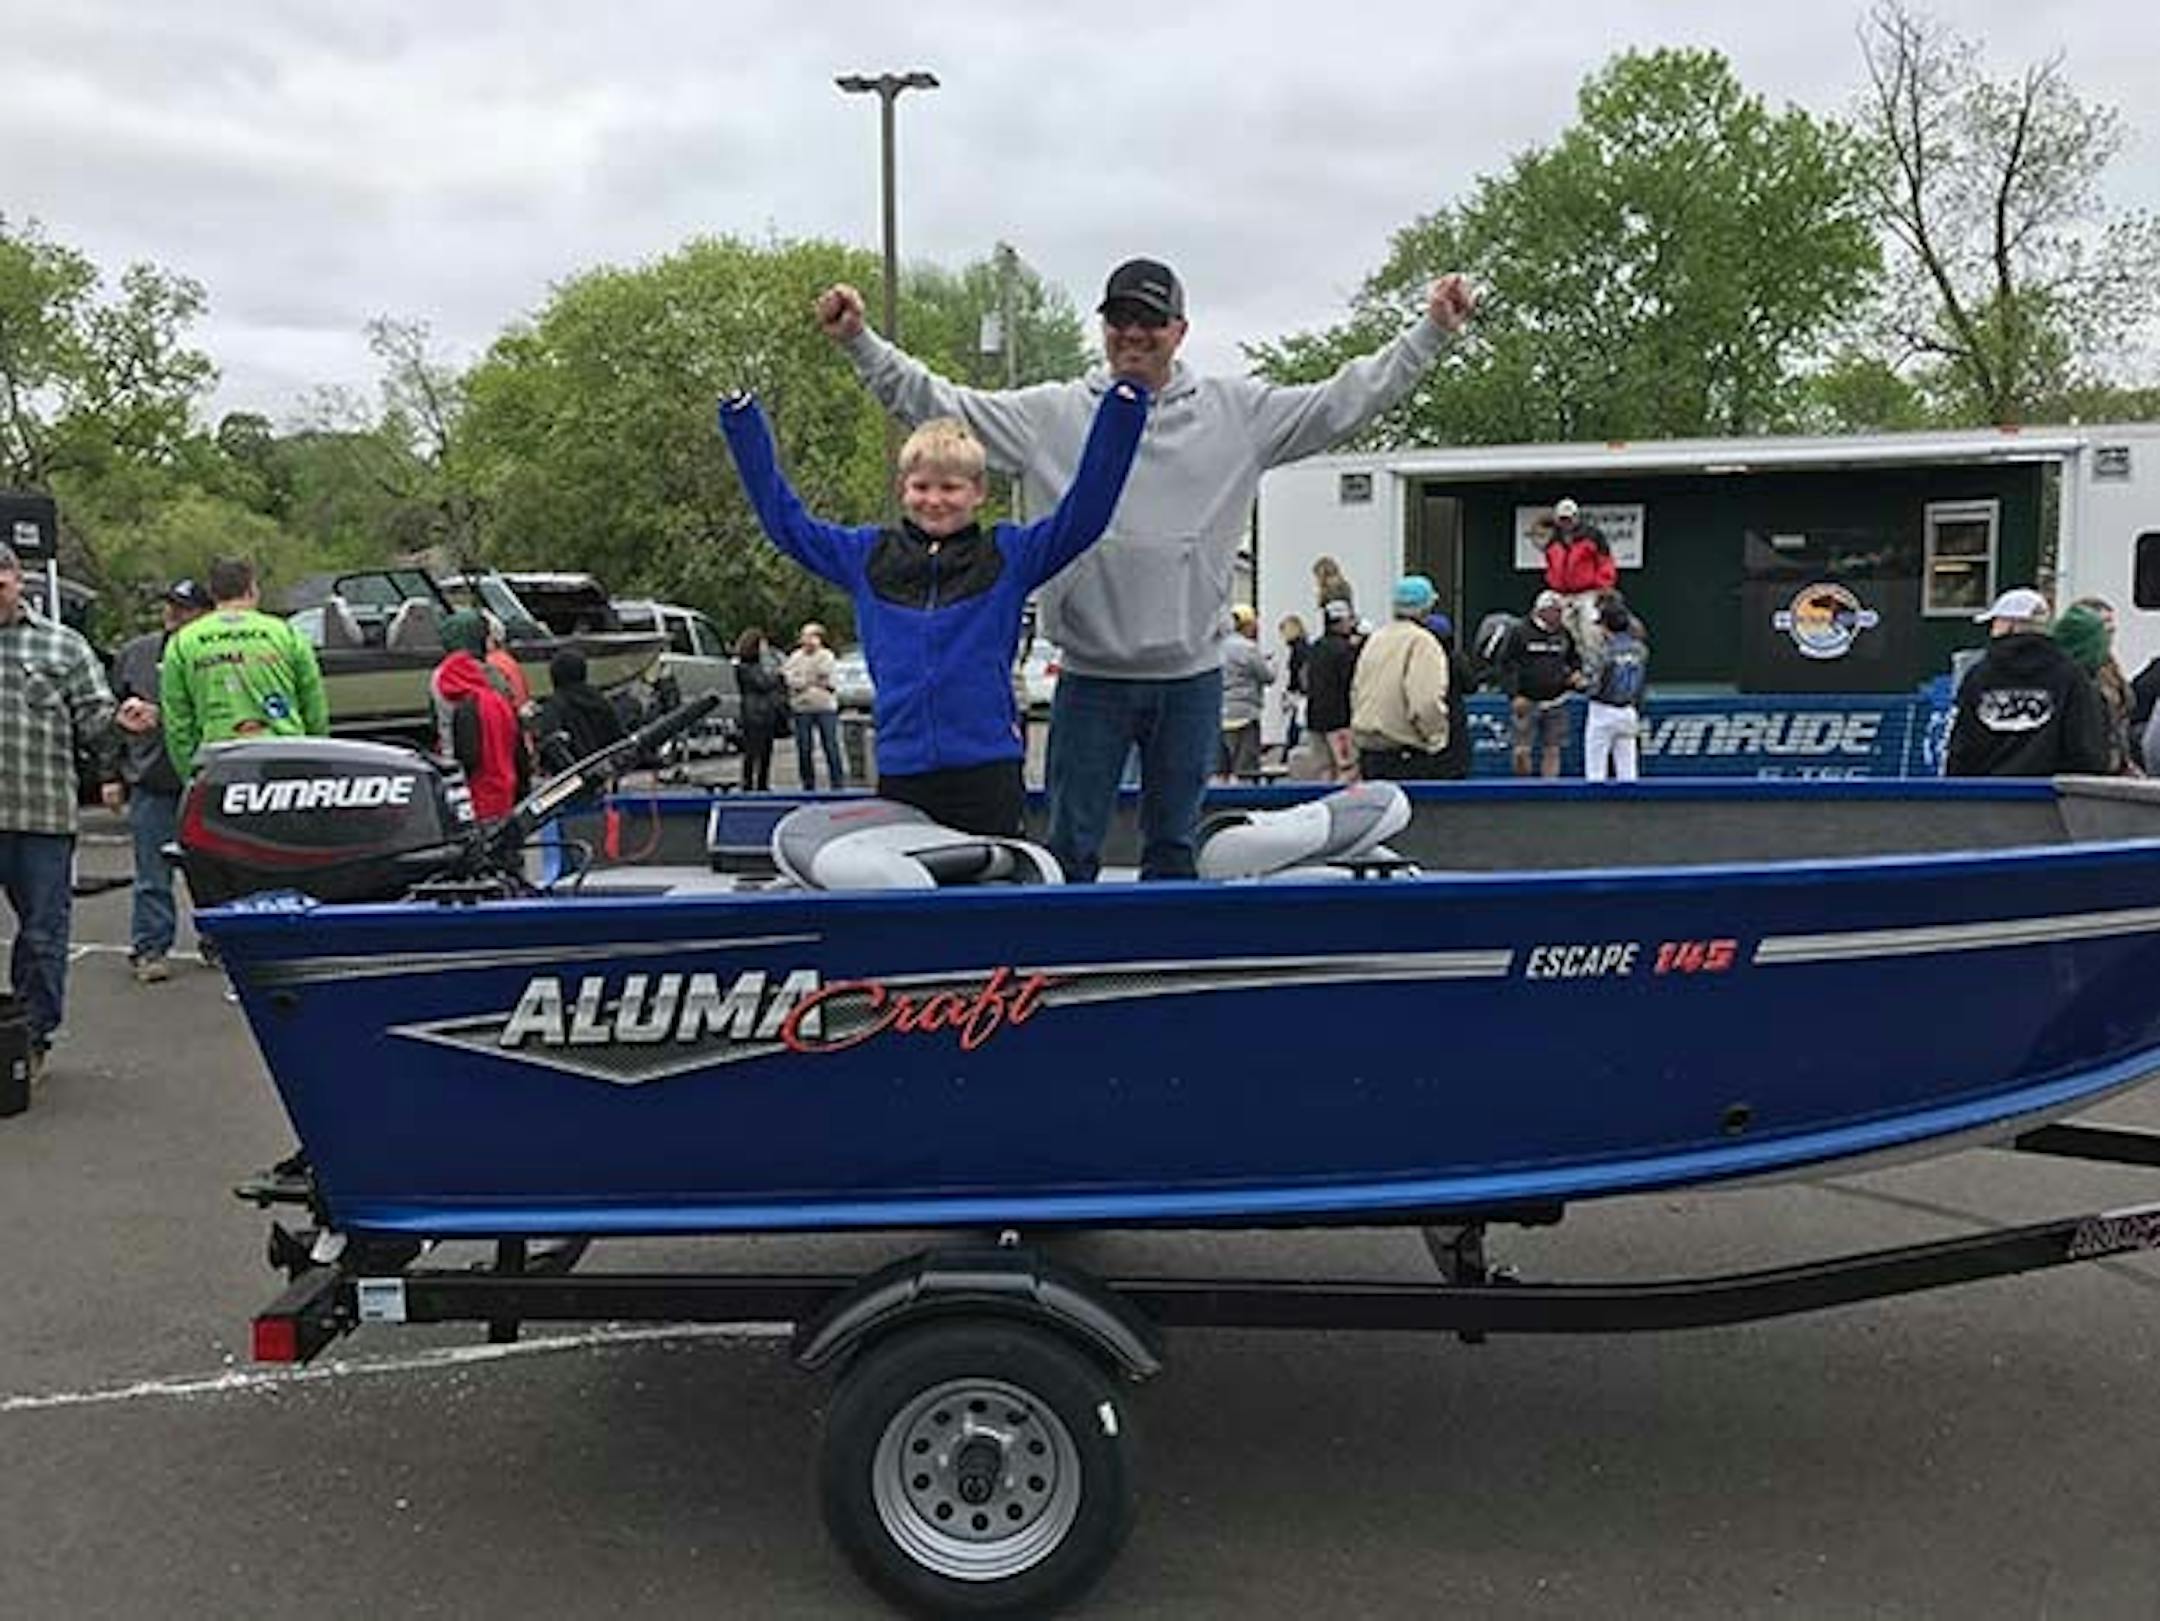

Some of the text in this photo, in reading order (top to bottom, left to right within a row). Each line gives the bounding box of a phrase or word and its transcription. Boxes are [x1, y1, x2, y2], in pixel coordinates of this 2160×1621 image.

[1638, 713, 1882, 756] VINRUDE
[222, 776, 416, 814] EVINRUDE
[1526, 942, 1640, 979] ESCAPE
